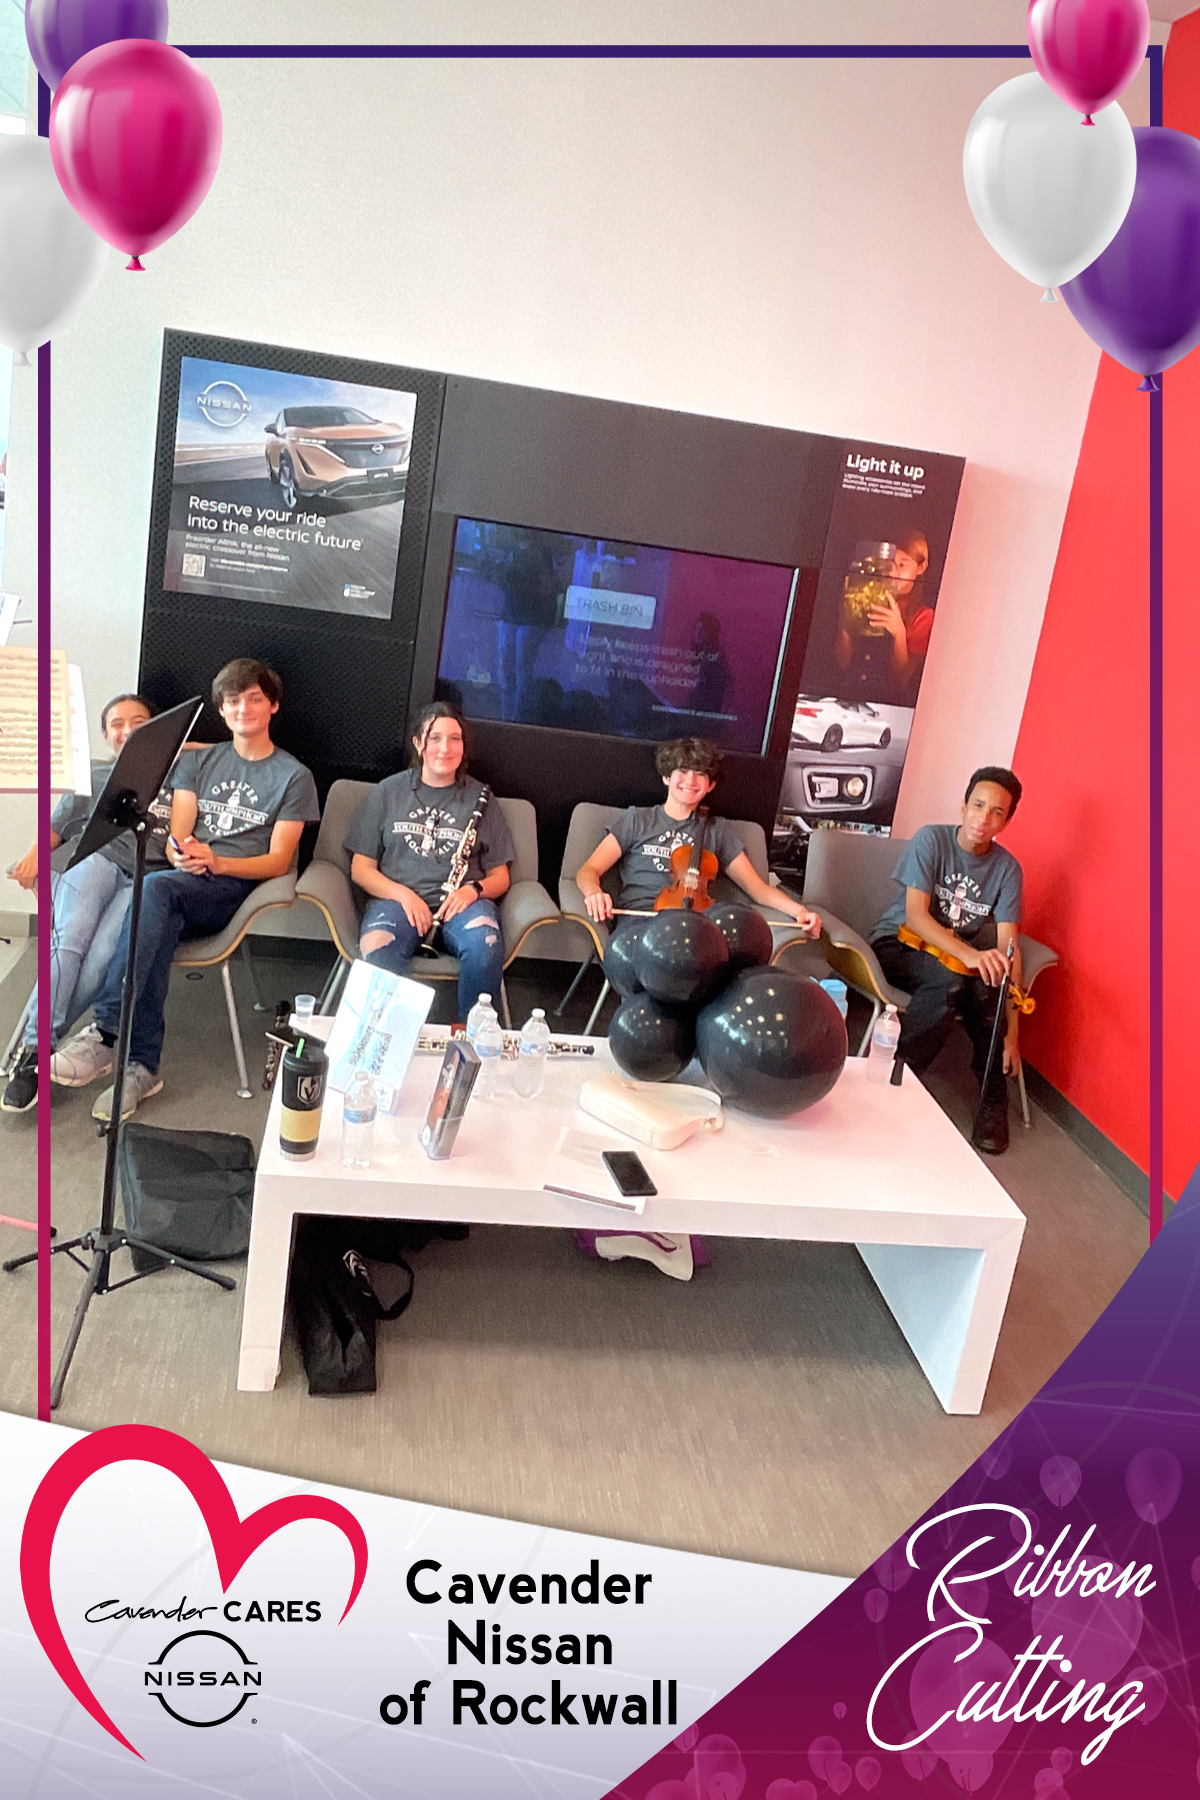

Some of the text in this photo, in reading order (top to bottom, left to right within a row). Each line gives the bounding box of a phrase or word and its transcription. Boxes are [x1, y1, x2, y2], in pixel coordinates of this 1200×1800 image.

[197, 396, 251, 411] NISSAN
[846, 454, 925, 481] Light it up
[189, 495, 326, 528] Reserve your ride
[187, 513, 218, 530] into
[223, 517, 249, 534] the
[253, 523, 310, 544] electric
[248, 549, 265, 558] from
[577, 597, 643, 617] TRASH BIN
[615, 638, 650, 653] keeps
[684, 649, 705, 661] out
[707, 651, 719, 662] of
[575, 663, 588, 674] to
[590, 663, 601, 675] fit
[604, 666, 615, 677] in
[635, 657, 644, 667] is
[645, 658, 701, 674] designed
[212, 780, 259, 804] GREATER
[409, 806, 456, 825] GREATER
[394, 823, 424, 833] YOUTH
[404, 834, 455, 857] ROCKALL
[939, 900, 977, 928] ROWALL
